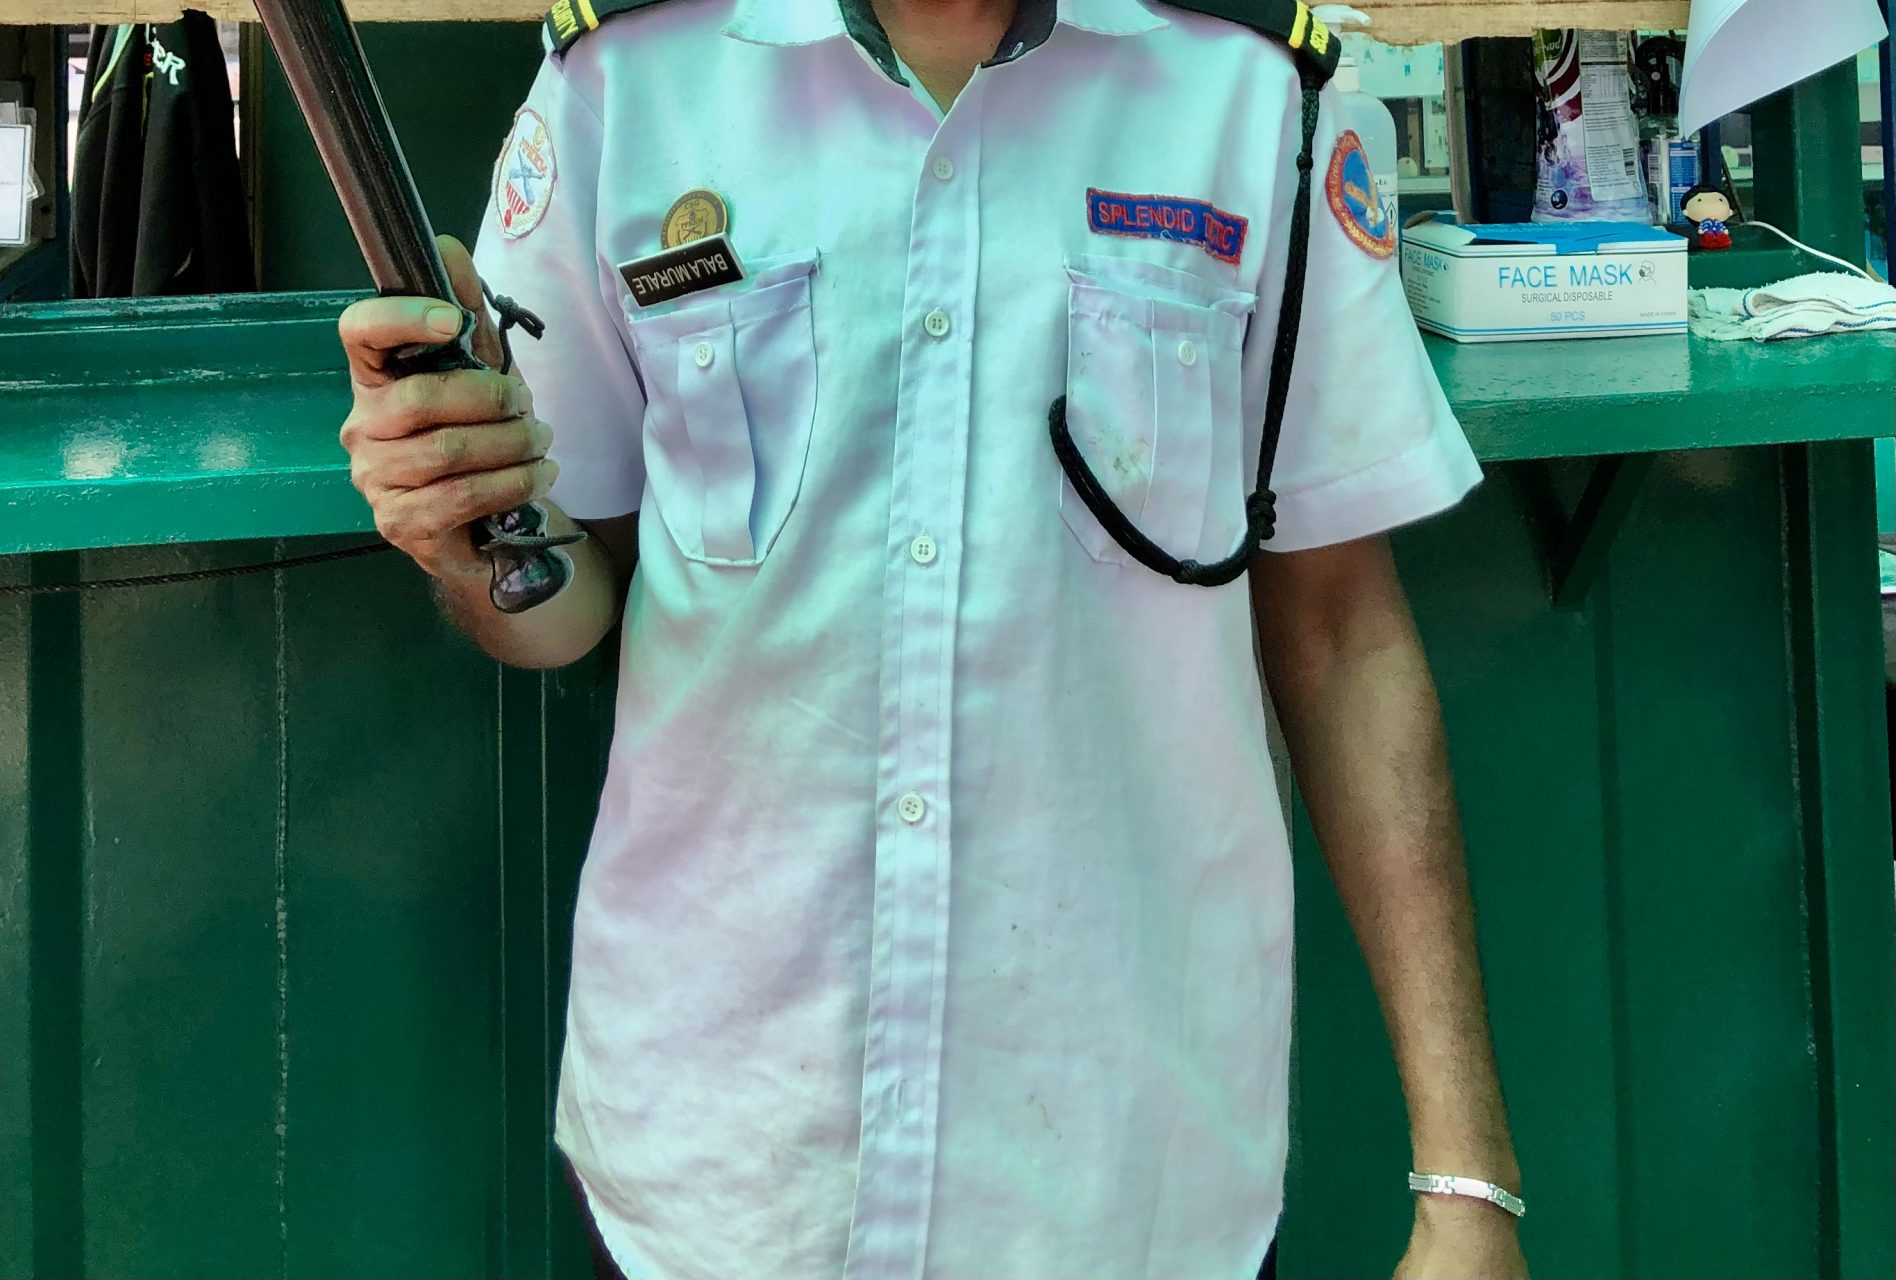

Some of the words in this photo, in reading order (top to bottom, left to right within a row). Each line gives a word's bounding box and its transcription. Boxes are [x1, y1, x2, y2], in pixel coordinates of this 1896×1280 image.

[1099, 201, 1195, 234] SPLENDID
[1498, 265, 1557, 288] FACE
[1570, 264, 1633, 287] MASK
[1522, 293, 1562, 303] SURGICAL
[1564, 291, 1613, 302] DISPOSABLE
[1550, 311, 1562, 322] 50
[1565, 310, 1585, 321] PCS
